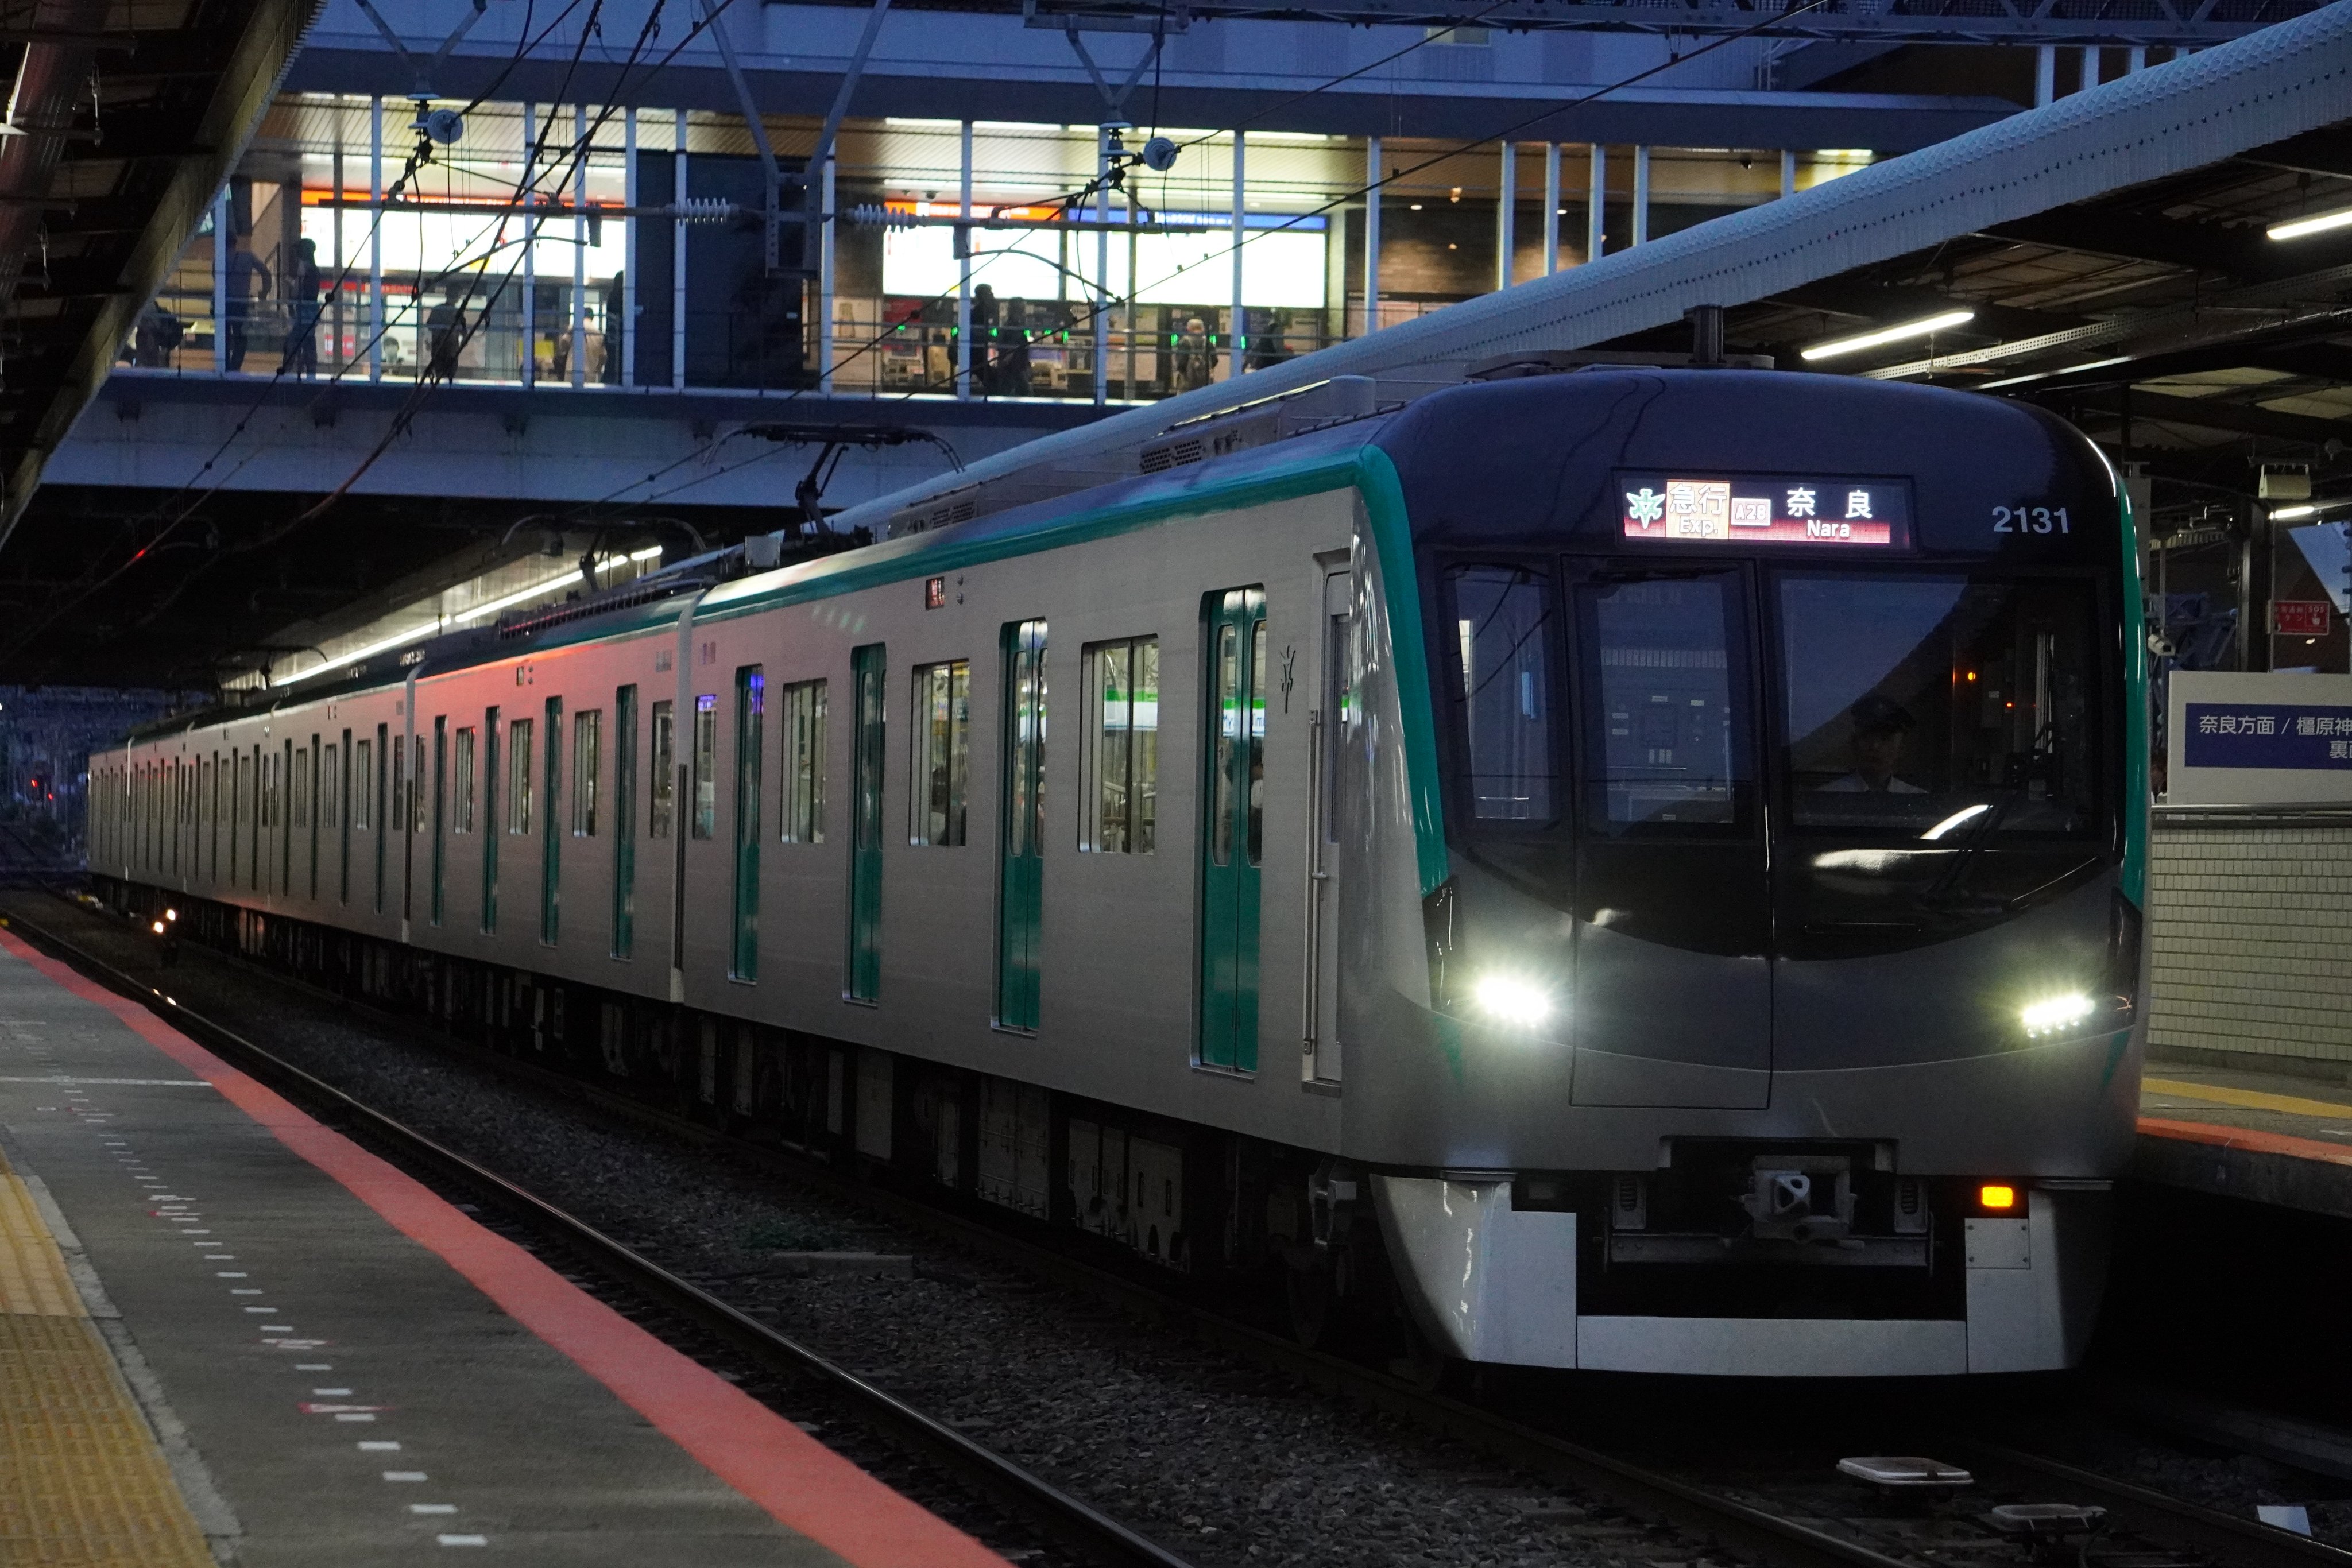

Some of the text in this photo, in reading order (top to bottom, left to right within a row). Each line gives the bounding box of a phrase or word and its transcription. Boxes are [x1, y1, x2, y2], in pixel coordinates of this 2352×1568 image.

[1669, 483, 1727, 514] 急行
[1786, 487, 1873, 519] 奈良
[1735, 504, 1766, 521] A28
[1991, 506, 2069, 534] 2131
[1679, 516, 1719, 537] Exp.
[1806, 519, 1850, 538] Nara
[2200, 714, 2276, 735] 奈良方面
[2329, 740, 2352, 759] 裏
